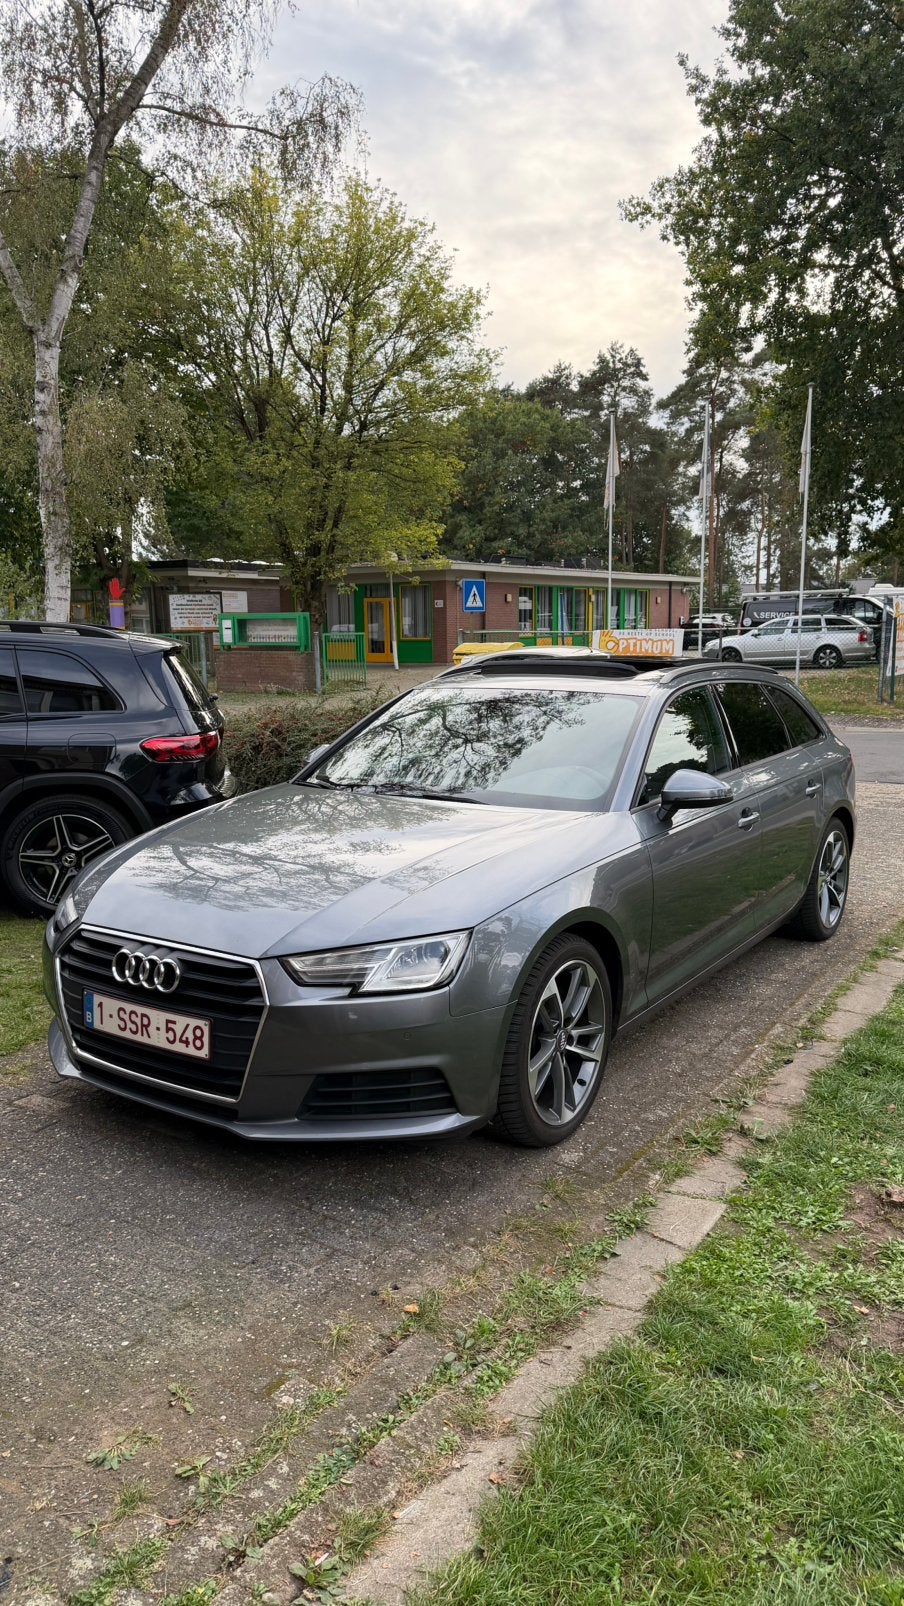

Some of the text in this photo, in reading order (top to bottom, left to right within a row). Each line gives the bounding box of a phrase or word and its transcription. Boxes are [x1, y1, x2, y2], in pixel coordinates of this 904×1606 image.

[760, 611, 796, 619] SERVICE
[86, 1011, 93, 1023] B
[97, 1001, 205, 1051] 1-SSR-548
